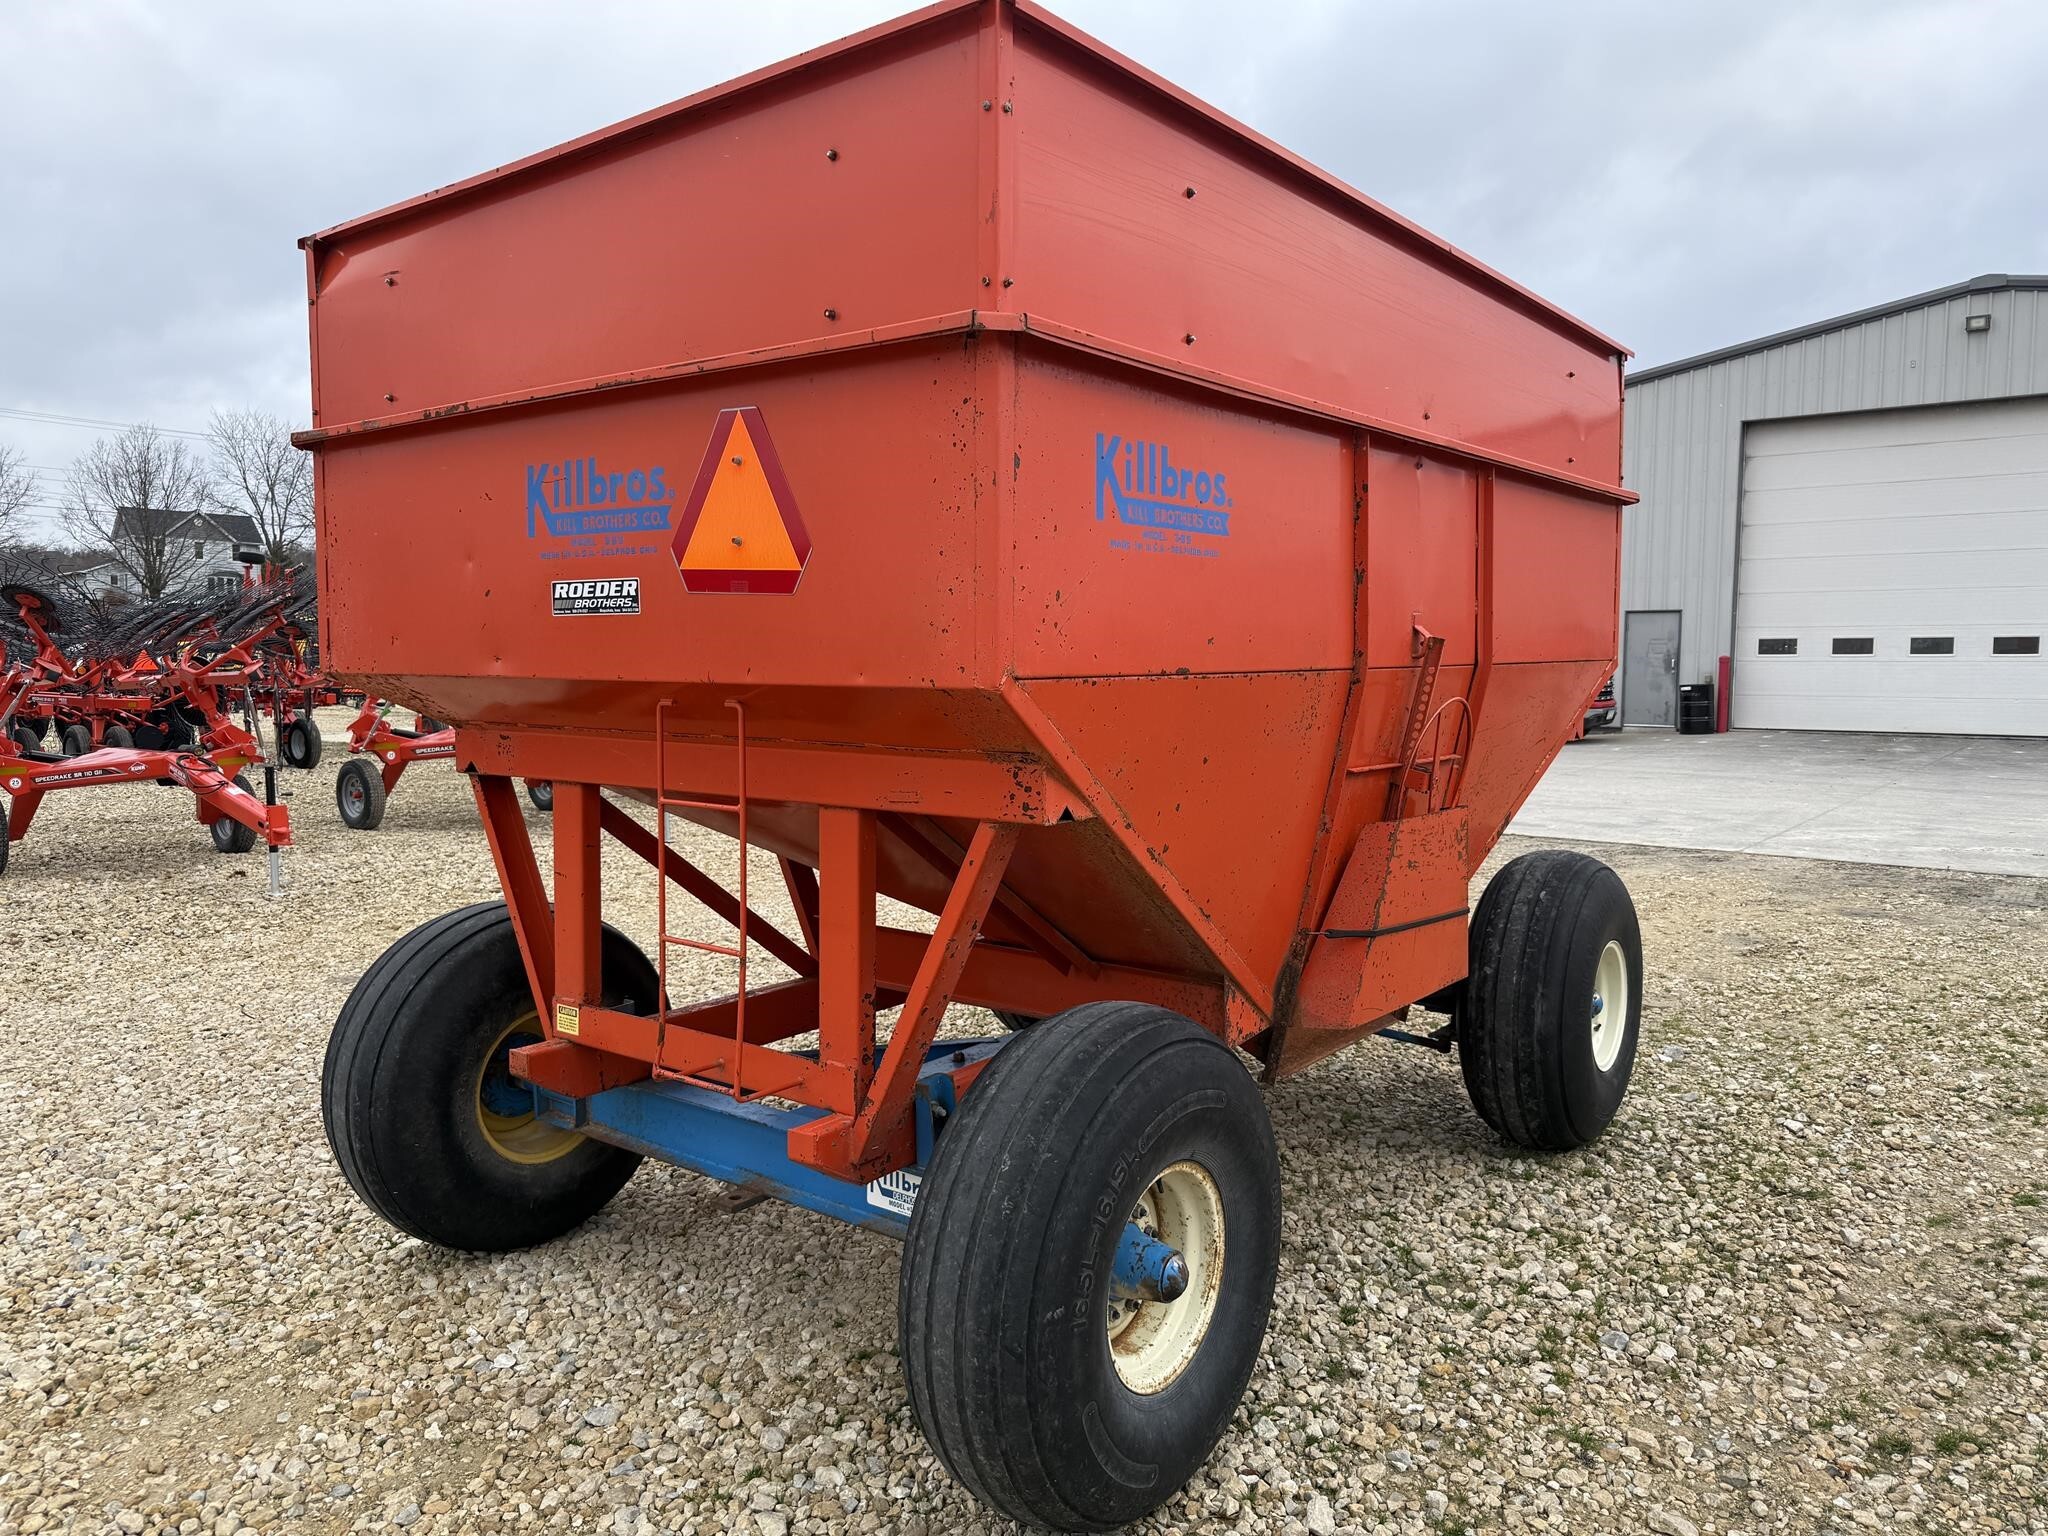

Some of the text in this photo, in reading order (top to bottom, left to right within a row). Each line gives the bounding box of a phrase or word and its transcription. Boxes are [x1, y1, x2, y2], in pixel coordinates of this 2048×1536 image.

[1127, 503, 1148, 522] KILL
[1154, 508, 1204, 529] BROTHERS
[556, 511, 664, 533] KILL BROTHERS CO.
[554, 580, 638, 599] ROEDER
[574, 597, 633, 608] BROTHERS
[415, 745, 454, 754] SPEEDRAKE
[130, 764, 146, 772] KUHN
[35, 773, 72, 783] SPEEDRAKE
[888, 1199, 905, 1211] MODEL
